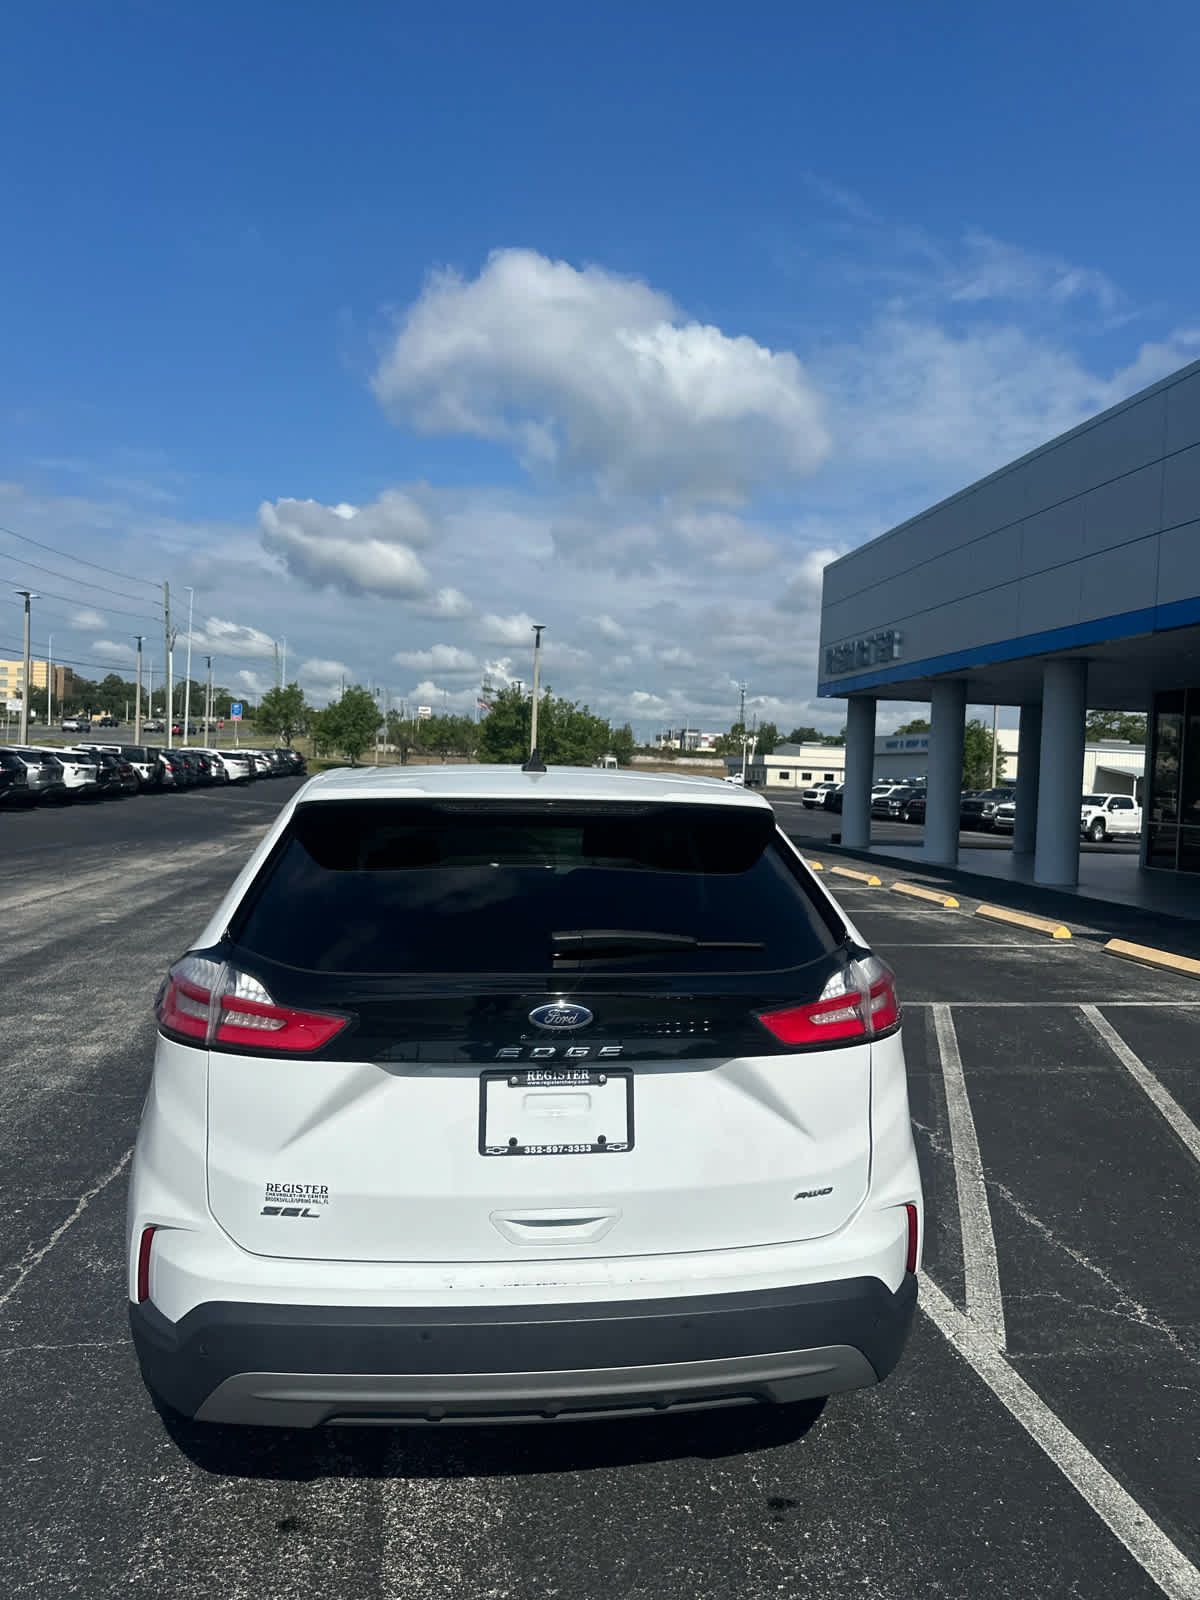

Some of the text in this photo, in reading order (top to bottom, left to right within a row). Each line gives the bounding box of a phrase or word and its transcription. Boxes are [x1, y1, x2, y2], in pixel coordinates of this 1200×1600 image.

[544, 1008, 578, 1025] Ford
[496, 1045, 624, 1058] EDGE
[527, 1070, 590, 1081] REGISTER
[524, 1144, 592, 1154] 352-597-3333
[266, 1183, 329, 1195] REGISTER
[794, 1187, 833, 1200] AWD
[260, 1206, 320, 1218] SEL
